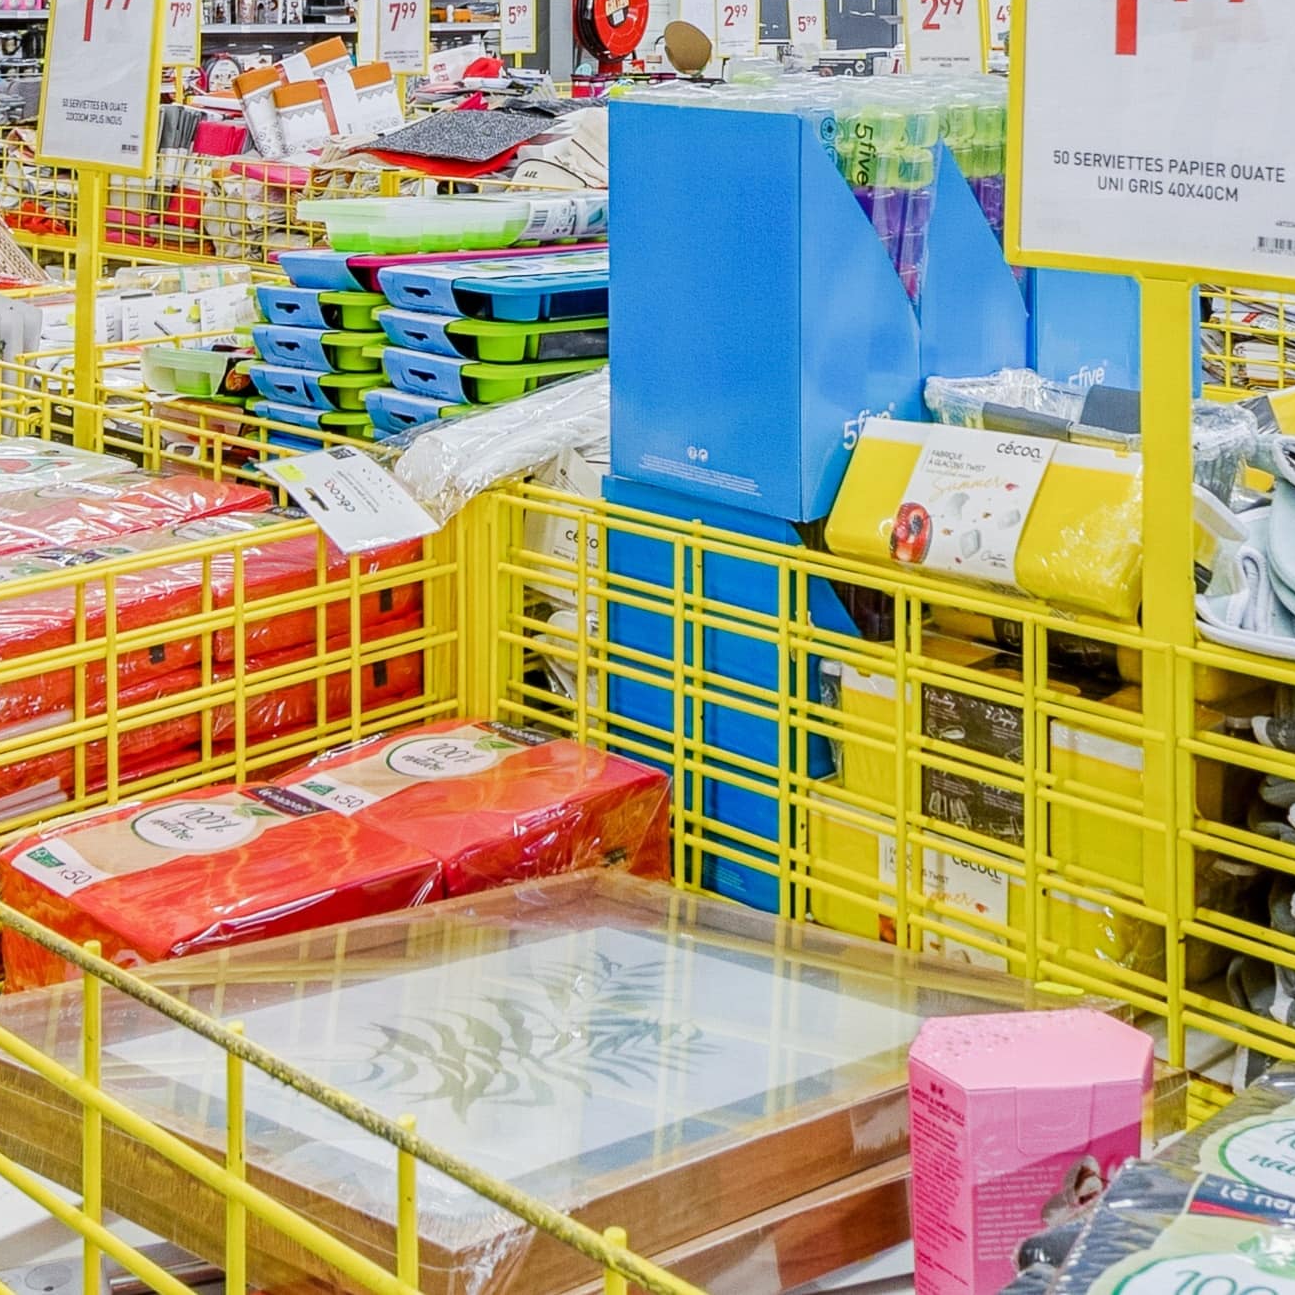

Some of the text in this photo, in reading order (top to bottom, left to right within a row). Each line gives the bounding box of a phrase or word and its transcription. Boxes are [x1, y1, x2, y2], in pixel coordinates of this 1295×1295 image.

[856, 122, 876, 186] 5five
[1053, 150, 1286, 183] 50 SERVIETTES PAPIER OUATE
[1097, 176, 1239, 202] UNI GRIS 40X40CM
[179, 805, 241, 833] 100%
[57, 867, 92, 885] x50
